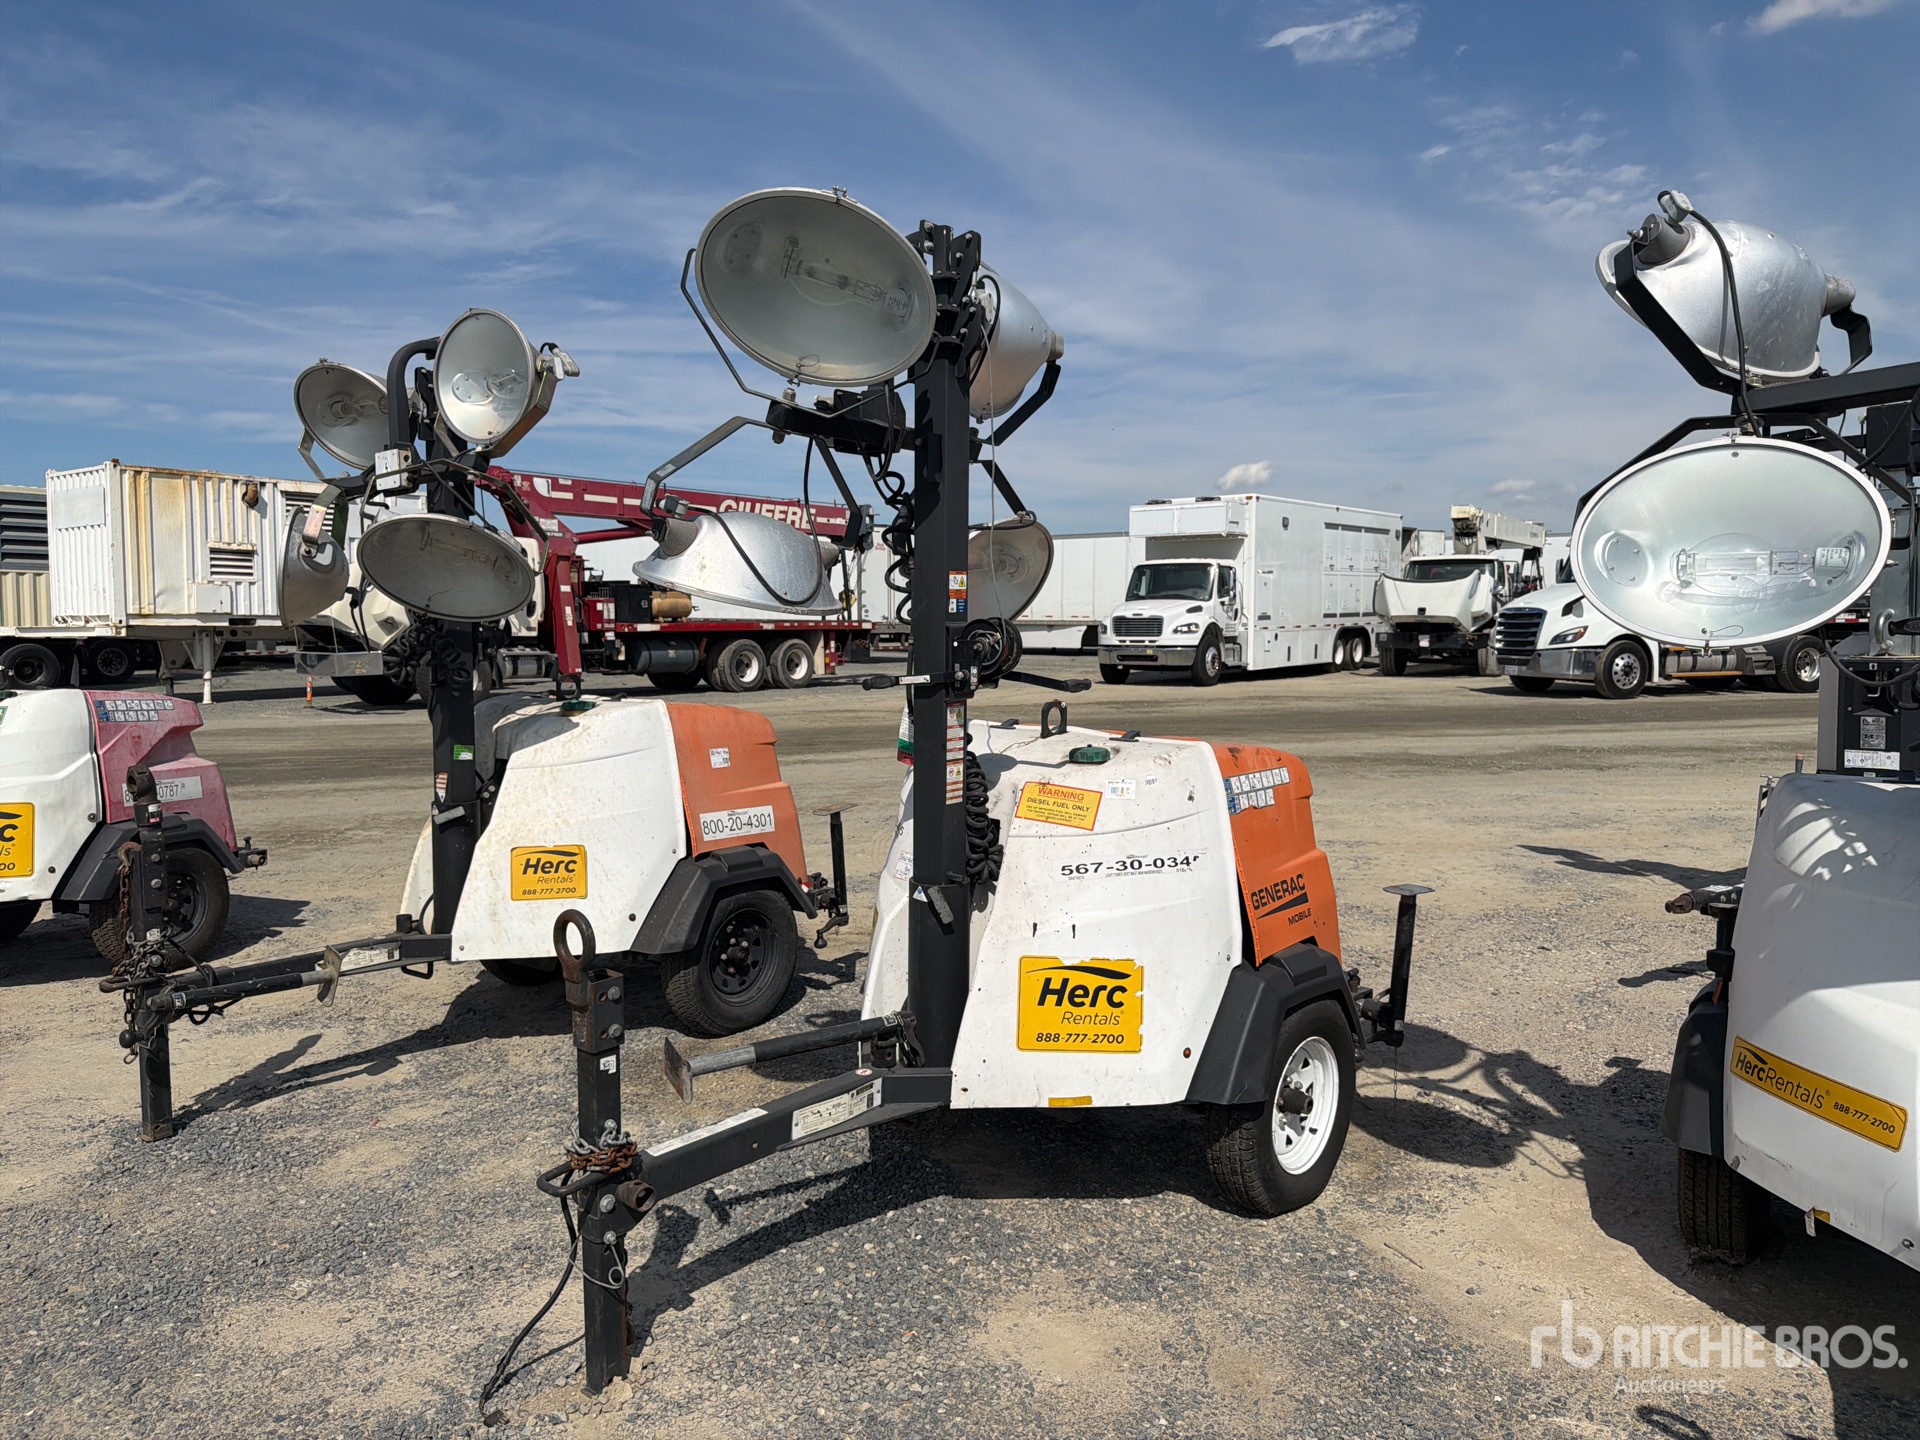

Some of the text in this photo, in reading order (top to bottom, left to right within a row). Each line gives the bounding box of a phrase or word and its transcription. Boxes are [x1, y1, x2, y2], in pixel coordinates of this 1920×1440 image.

[1038, 787, 1085, 801] WARNING
[1027, 797, 1091, 813] DIESEL FUEL ONLY
[702, 813, 772, 835] 800-20-4301
[522, 858, 578, 875] Herc
[537, 875, 574, 885] Rentals
[521, 887, 577, 896] 888-777-2700
[1250, 873, 1306, 911] GENERAC
[1287, 907, 1312, 926] MOBILE
[1037, 977, 1128, 1008] Herc
[1061, 1011, 1120, 1026] Rentals
[1036, 1032, 1124, 1044] 888-777-2700
[1833, 1101, 1896, 1134] 888-777-2700
